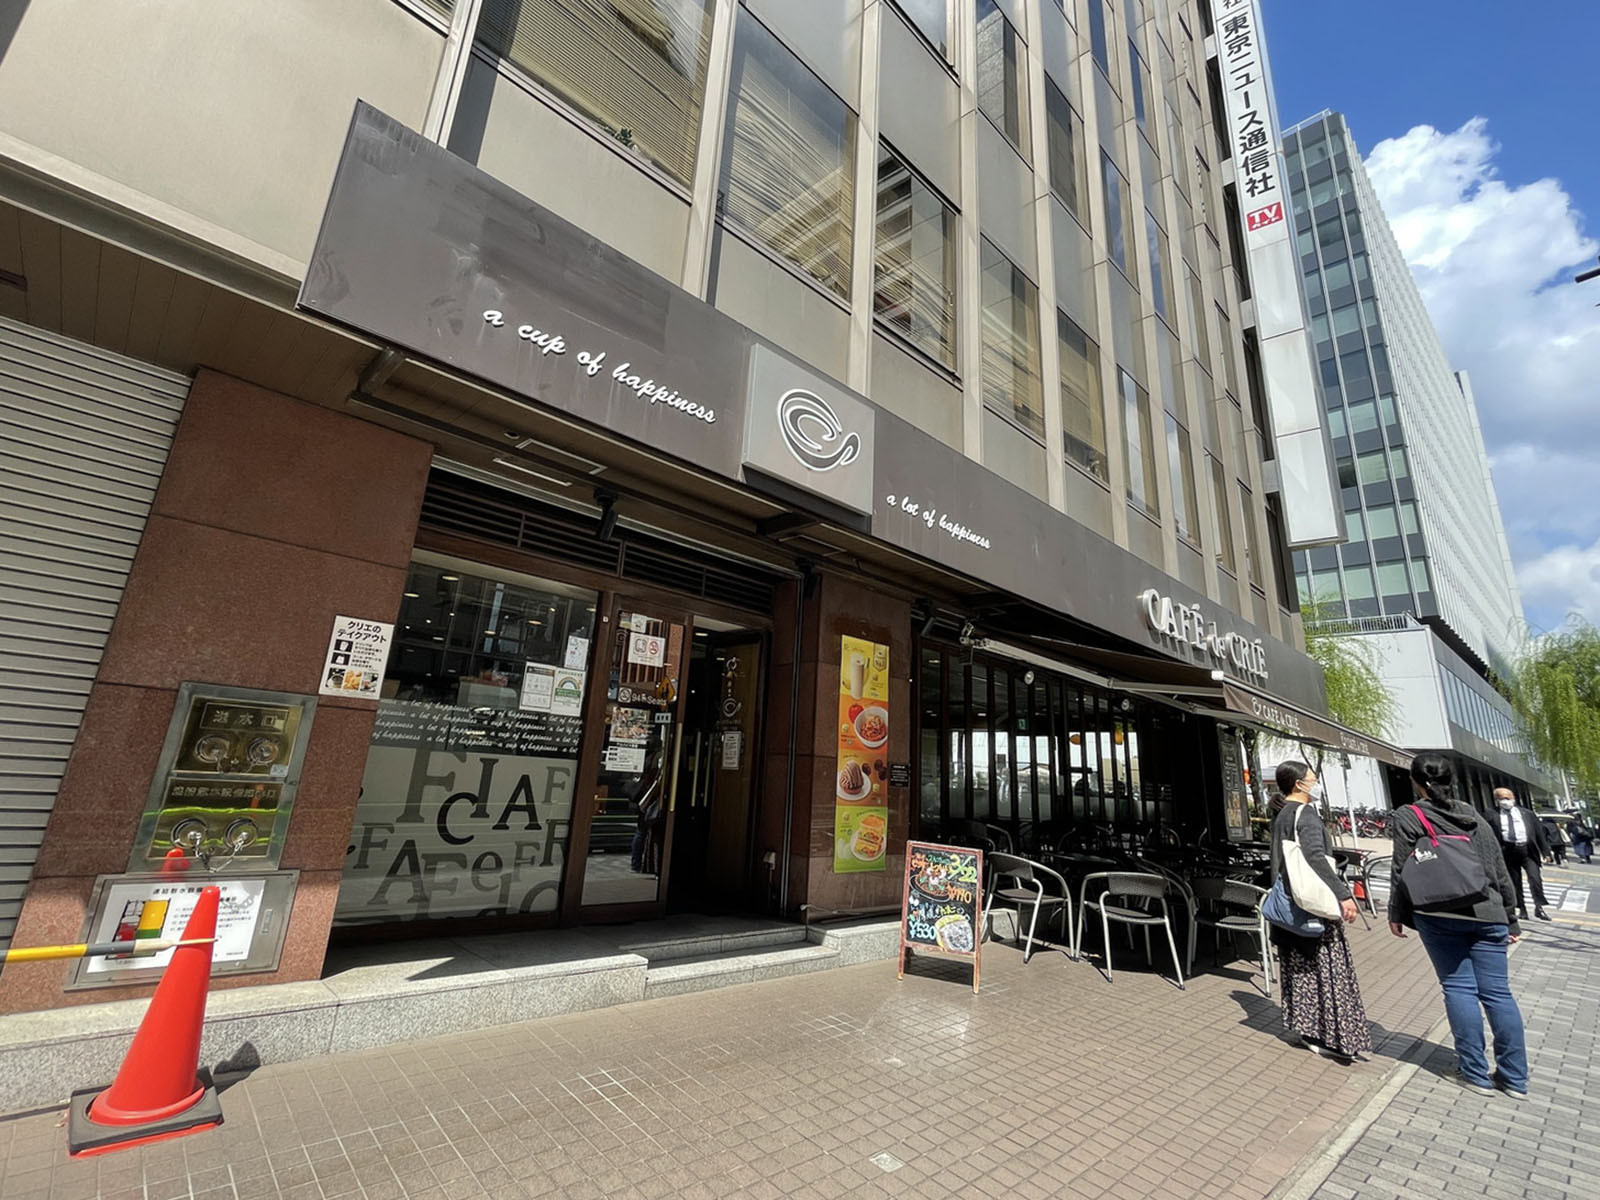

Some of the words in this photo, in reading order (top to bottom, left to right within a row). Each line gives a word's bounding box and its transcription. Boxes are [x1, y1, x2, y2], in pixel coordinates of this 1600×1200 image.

[1222, 11, 1276, 198] 東京ニュース通信社
[1249, 204, 1278, 223] TV
[483, 309, 504, 327] a
[518, 324, 566, 355] cup
[577, 350, 606, 376] of
[612, 362, 717, 424] happiness
[886, 494, 897, 506] a
[901, 496, 919, 516] lot
[922, 509, 936, 528] of
[939, 513, 991, 549] happiness
[337, 628, 387, 643] テイクアウト
[348, 621, 382, 633] クリエの
[1142, 588, 1208, 651] CAFÉ
[1207, 621, 1227, 660] de
[1225, 631, 1269, 679] CRIÉ
[908, 920, 937, 940] ¥530
